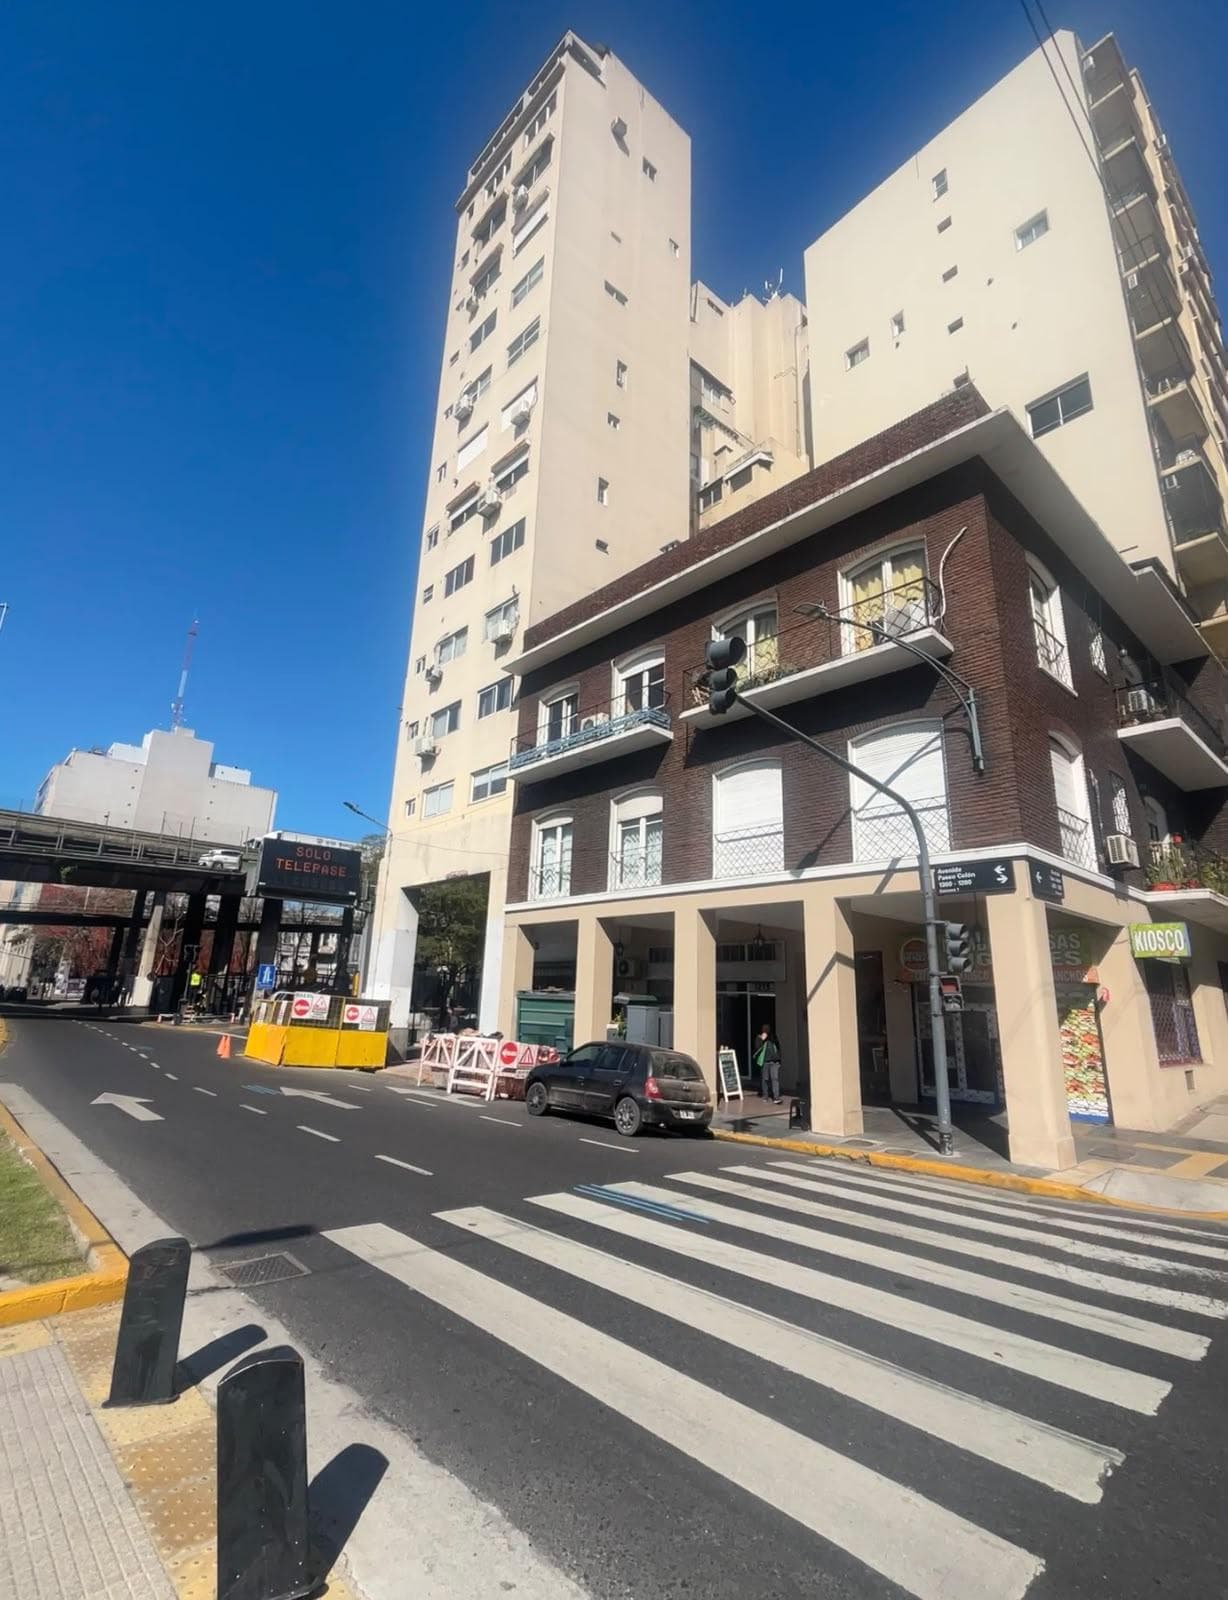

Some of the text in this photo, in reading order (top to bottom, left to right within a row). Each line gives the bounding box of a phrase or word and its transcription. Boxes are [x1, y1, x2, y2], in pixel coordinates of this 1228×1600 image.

[296, 846, 331, 860] SOLO
[275, 857, 347, 877] TELEPASE
[1134, 929, 1185, 952] KIOSCO
